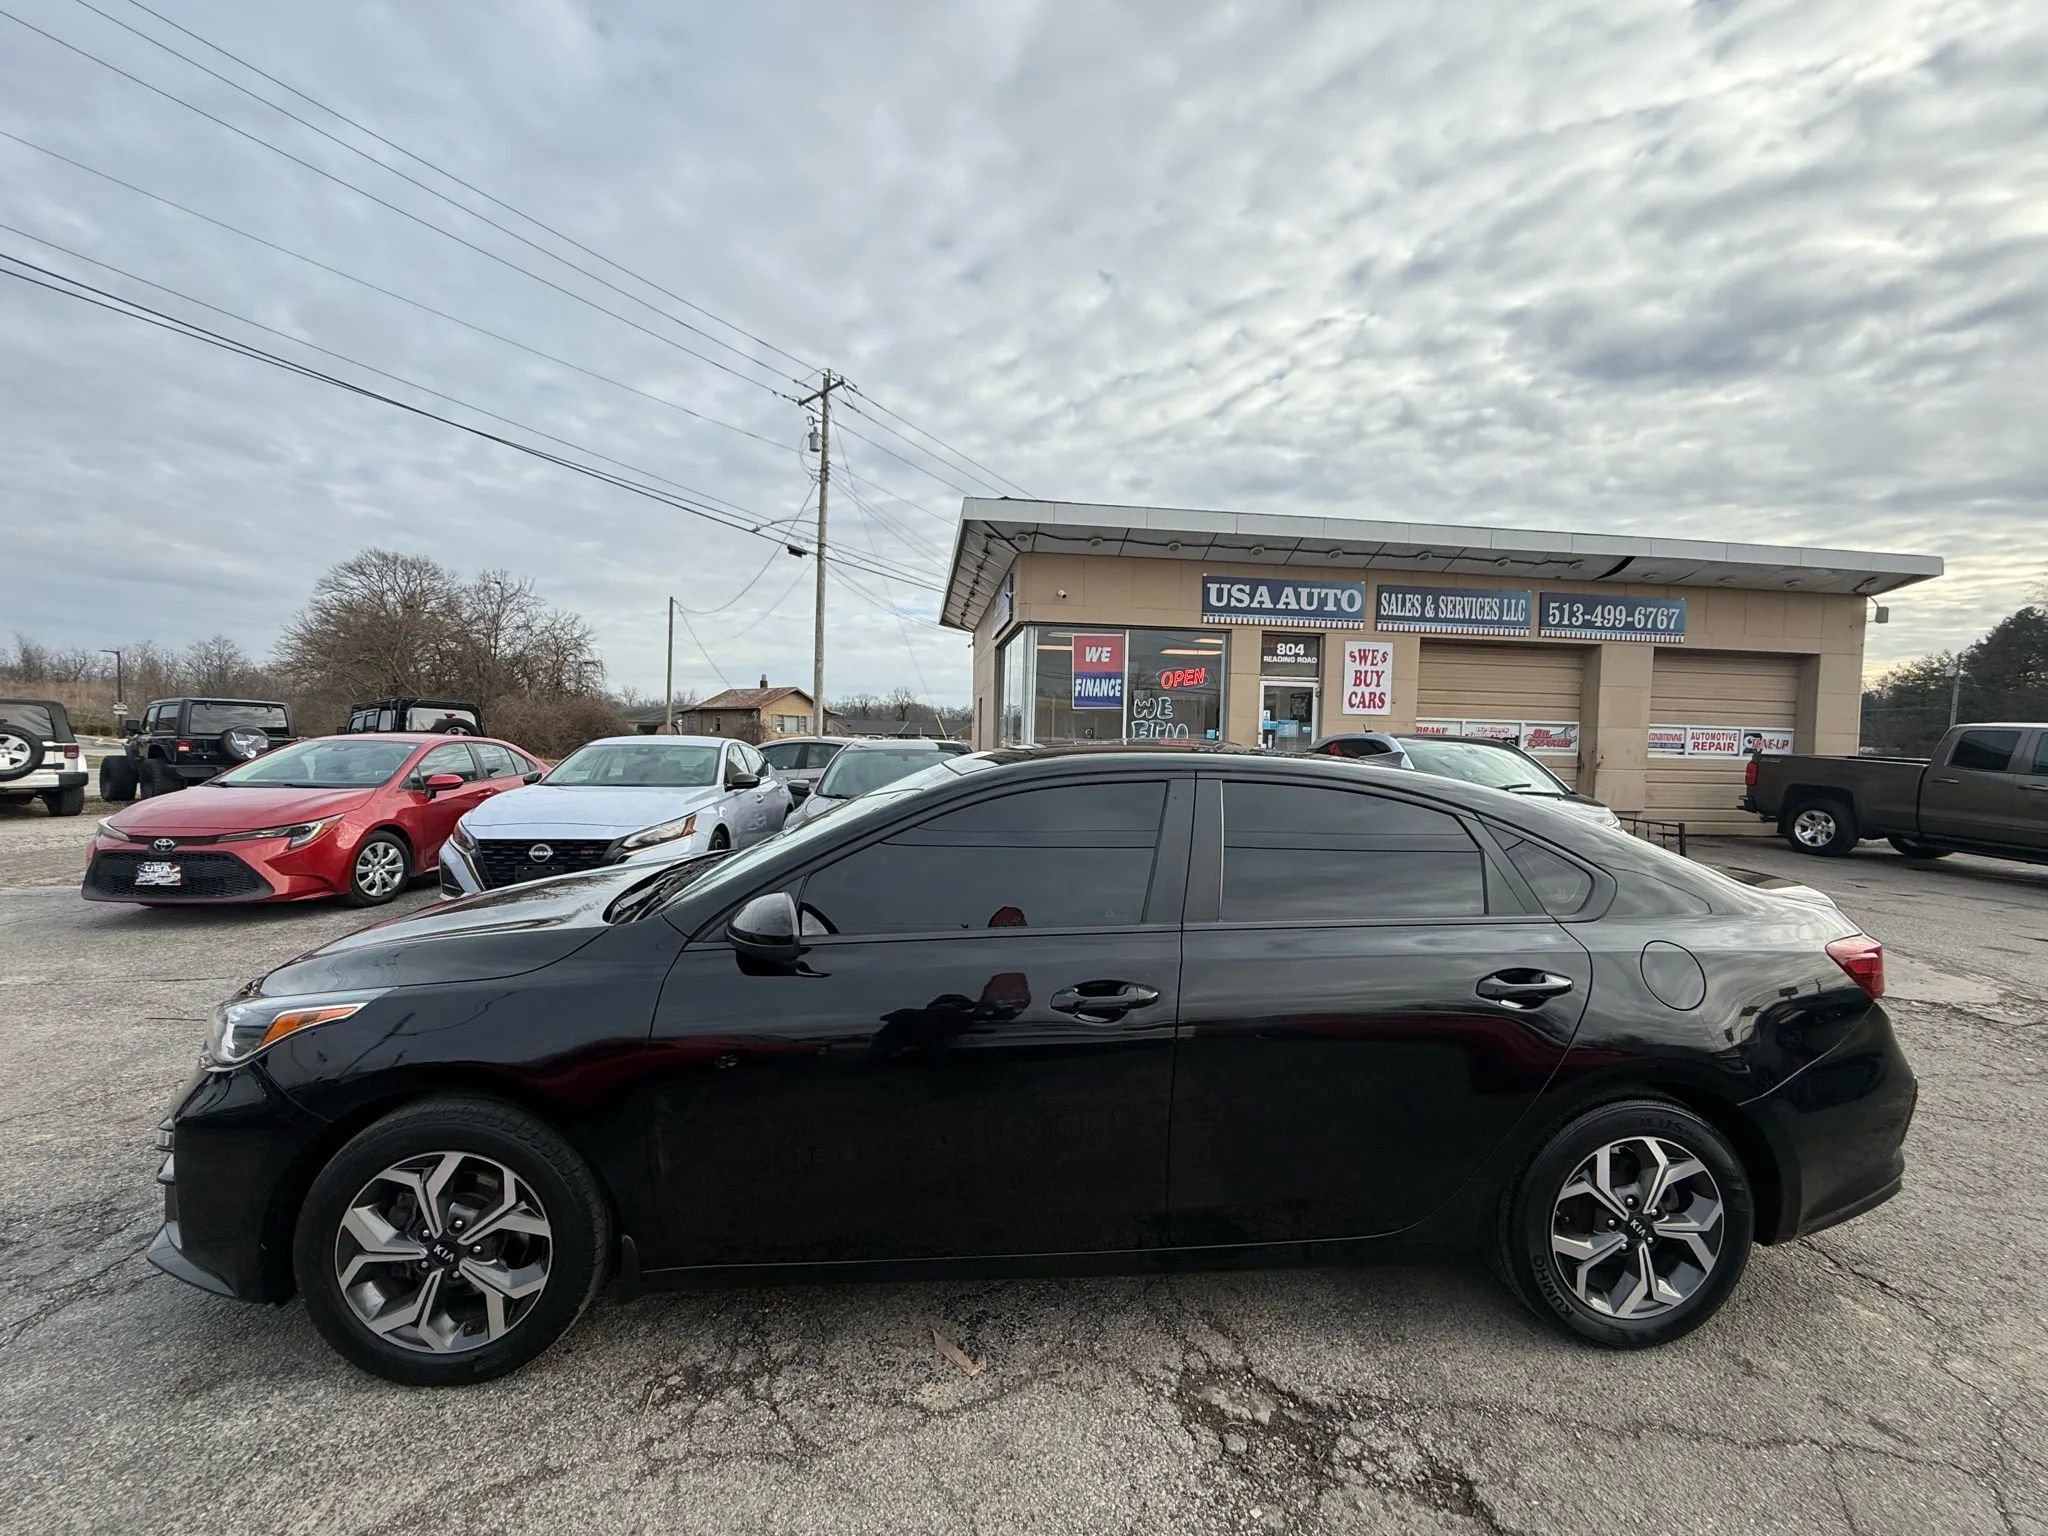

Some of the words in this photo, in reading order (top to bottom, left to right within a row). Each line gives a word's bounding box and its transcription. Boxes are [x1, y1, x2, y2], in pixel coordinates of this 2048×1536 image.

[1207, 583, 1274, 609] USA
[1276, 587, 1362, 613] AUTO
[1380, 592, 1422, 617] SALES
[1424, 595, 1436, 618] &
[1438, 596, 1500, 621] SERVICES
[1502, 599, 1526, 622] LLC
[1548, 602, 1680, 630] 513-499-6767
[1085, 646, 1112, 663] WE
[1276, 643, 1305, 656] 804
[1263, 655, 1296, 663] READING
[1297, 656, 1318, 664] ROAD
[1074, 678, 1122, 697] FINANCE
[1160, 667, 1206, 690] OPEN
[1353, 669, 1385, 688] BUY
[1133, 696, 1174, 720] WE
[1348, 691, 1386, 709] CARS
[1690, 732, 1738, 742] AUTOMOTIVE
[1692, 741, 1735, 752] REPAIR
[1630, 1219, 1646, 1237] KIA
[433, 1244, 455, 1263] KIA
[1532, 1254, 1575, 1316] KUMHO
